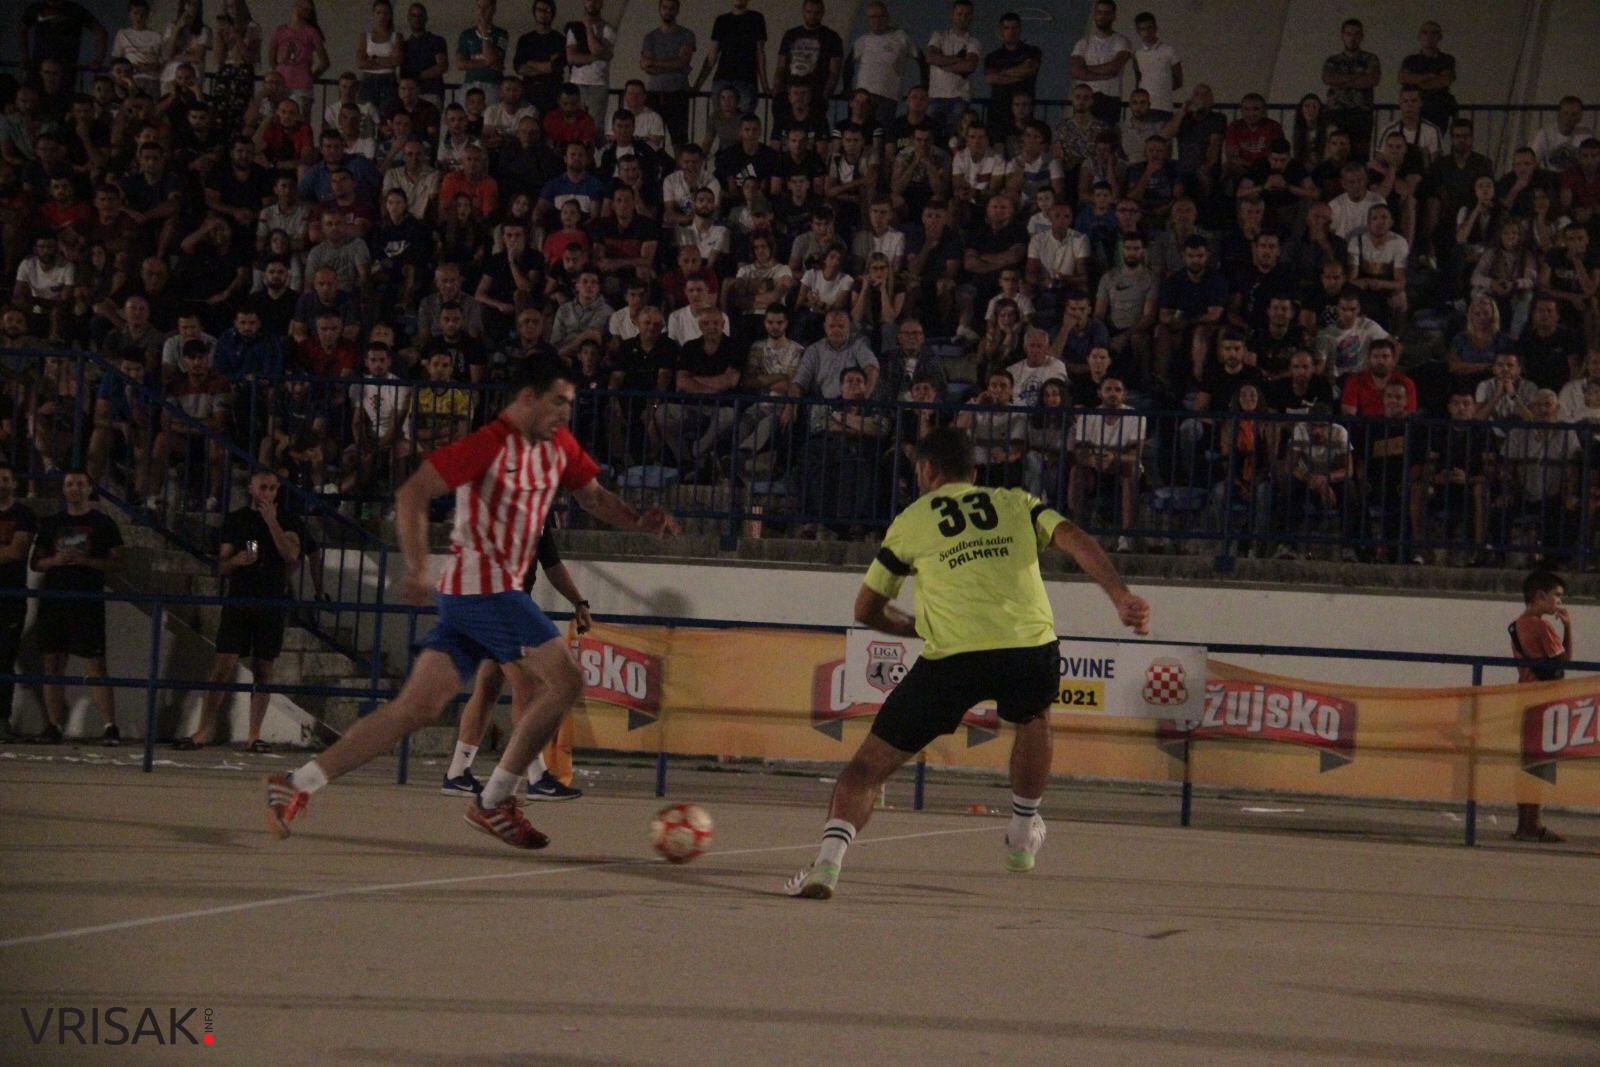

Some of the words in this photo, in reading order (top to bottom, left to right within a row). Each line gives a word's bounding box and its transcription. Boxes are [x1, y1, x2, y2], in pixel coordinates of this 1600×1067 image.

[931, 492, 999, 537] 33
[985, 535, 1014, 546] salon
[948, 547, 1009, 569] DALMATA
[873, 647, 898, 657] LIGA
[1058, 656, 1115, 679] OVINE
[1175, 684, 1341, 742] žujsko
